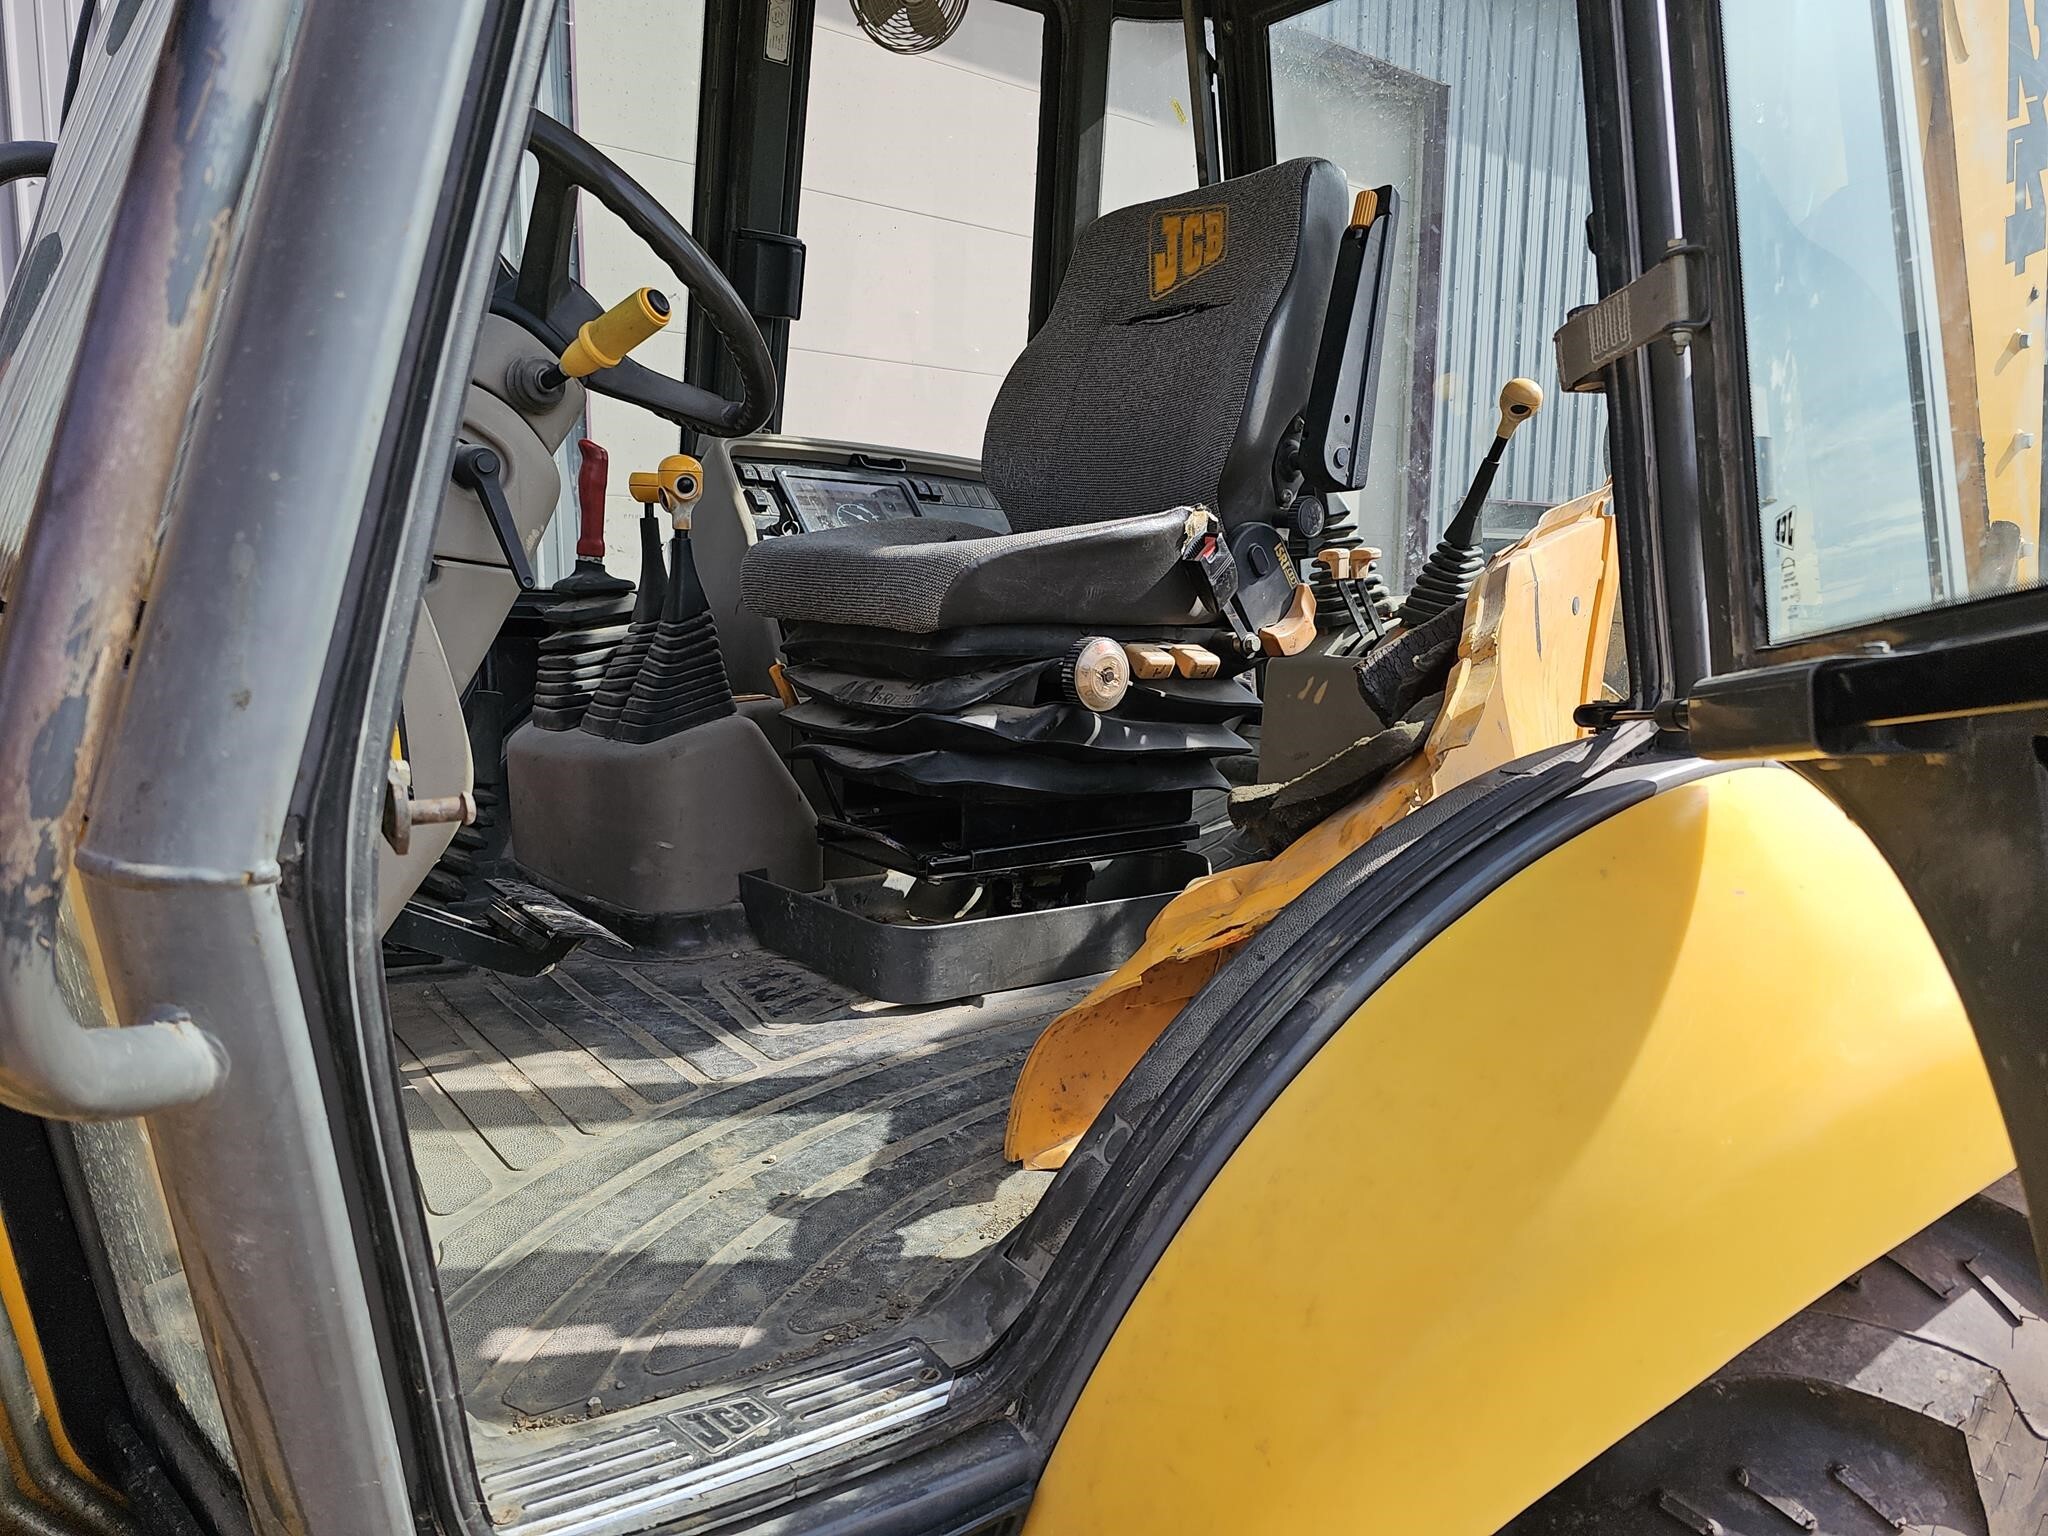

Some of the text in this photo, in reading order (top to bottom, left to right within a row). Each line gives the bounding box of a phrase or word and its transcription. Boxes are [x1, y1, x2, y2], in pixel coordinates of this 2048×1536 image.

[1153, 211, 1225, 293] JCB
[1273, 542, 1291, 570] ISRI
[682, 1401, 770, 1449] JCB
